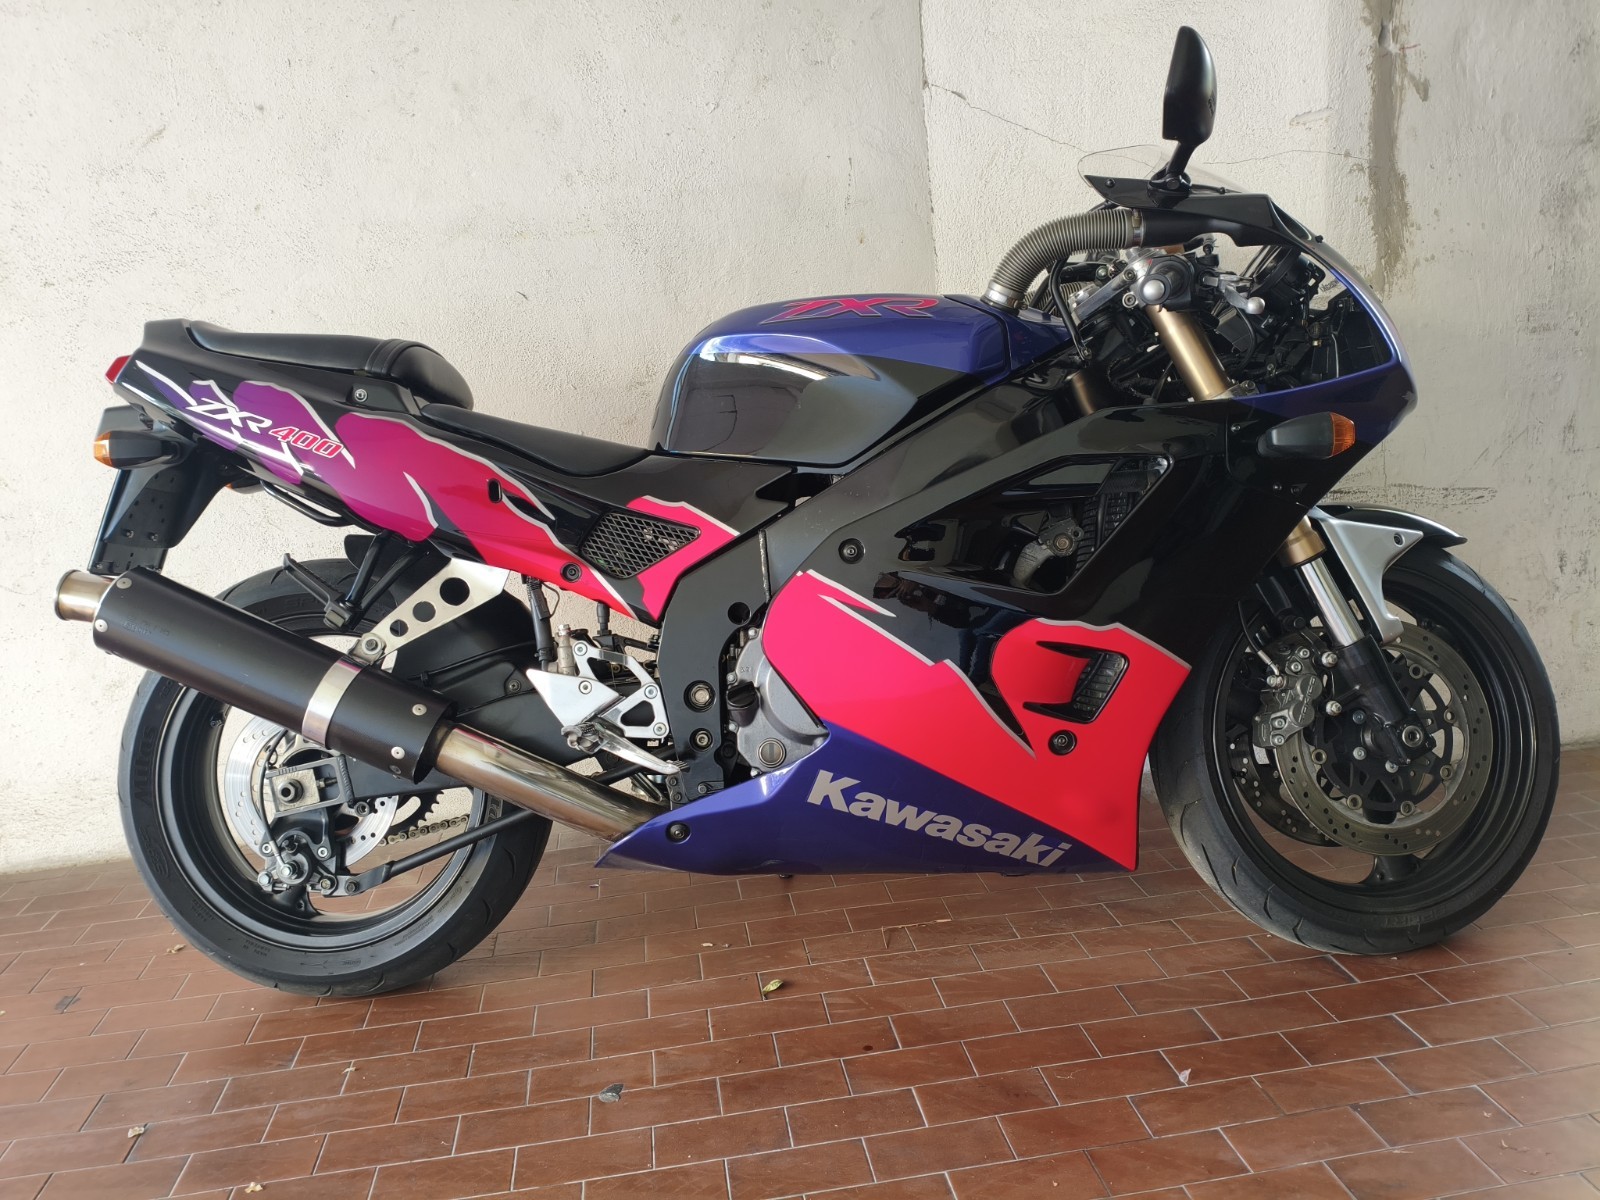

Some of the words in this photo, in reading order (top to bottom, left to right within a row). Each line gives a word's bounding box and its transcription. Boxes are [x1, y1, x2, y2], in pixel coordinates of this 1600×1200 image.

[758, 297, 939, 325] ZXR
[185, 397, 273, 434] ZXR
[268, 426, 344, 458] 400
[807, 769, 1072, 867] Kawasaki
